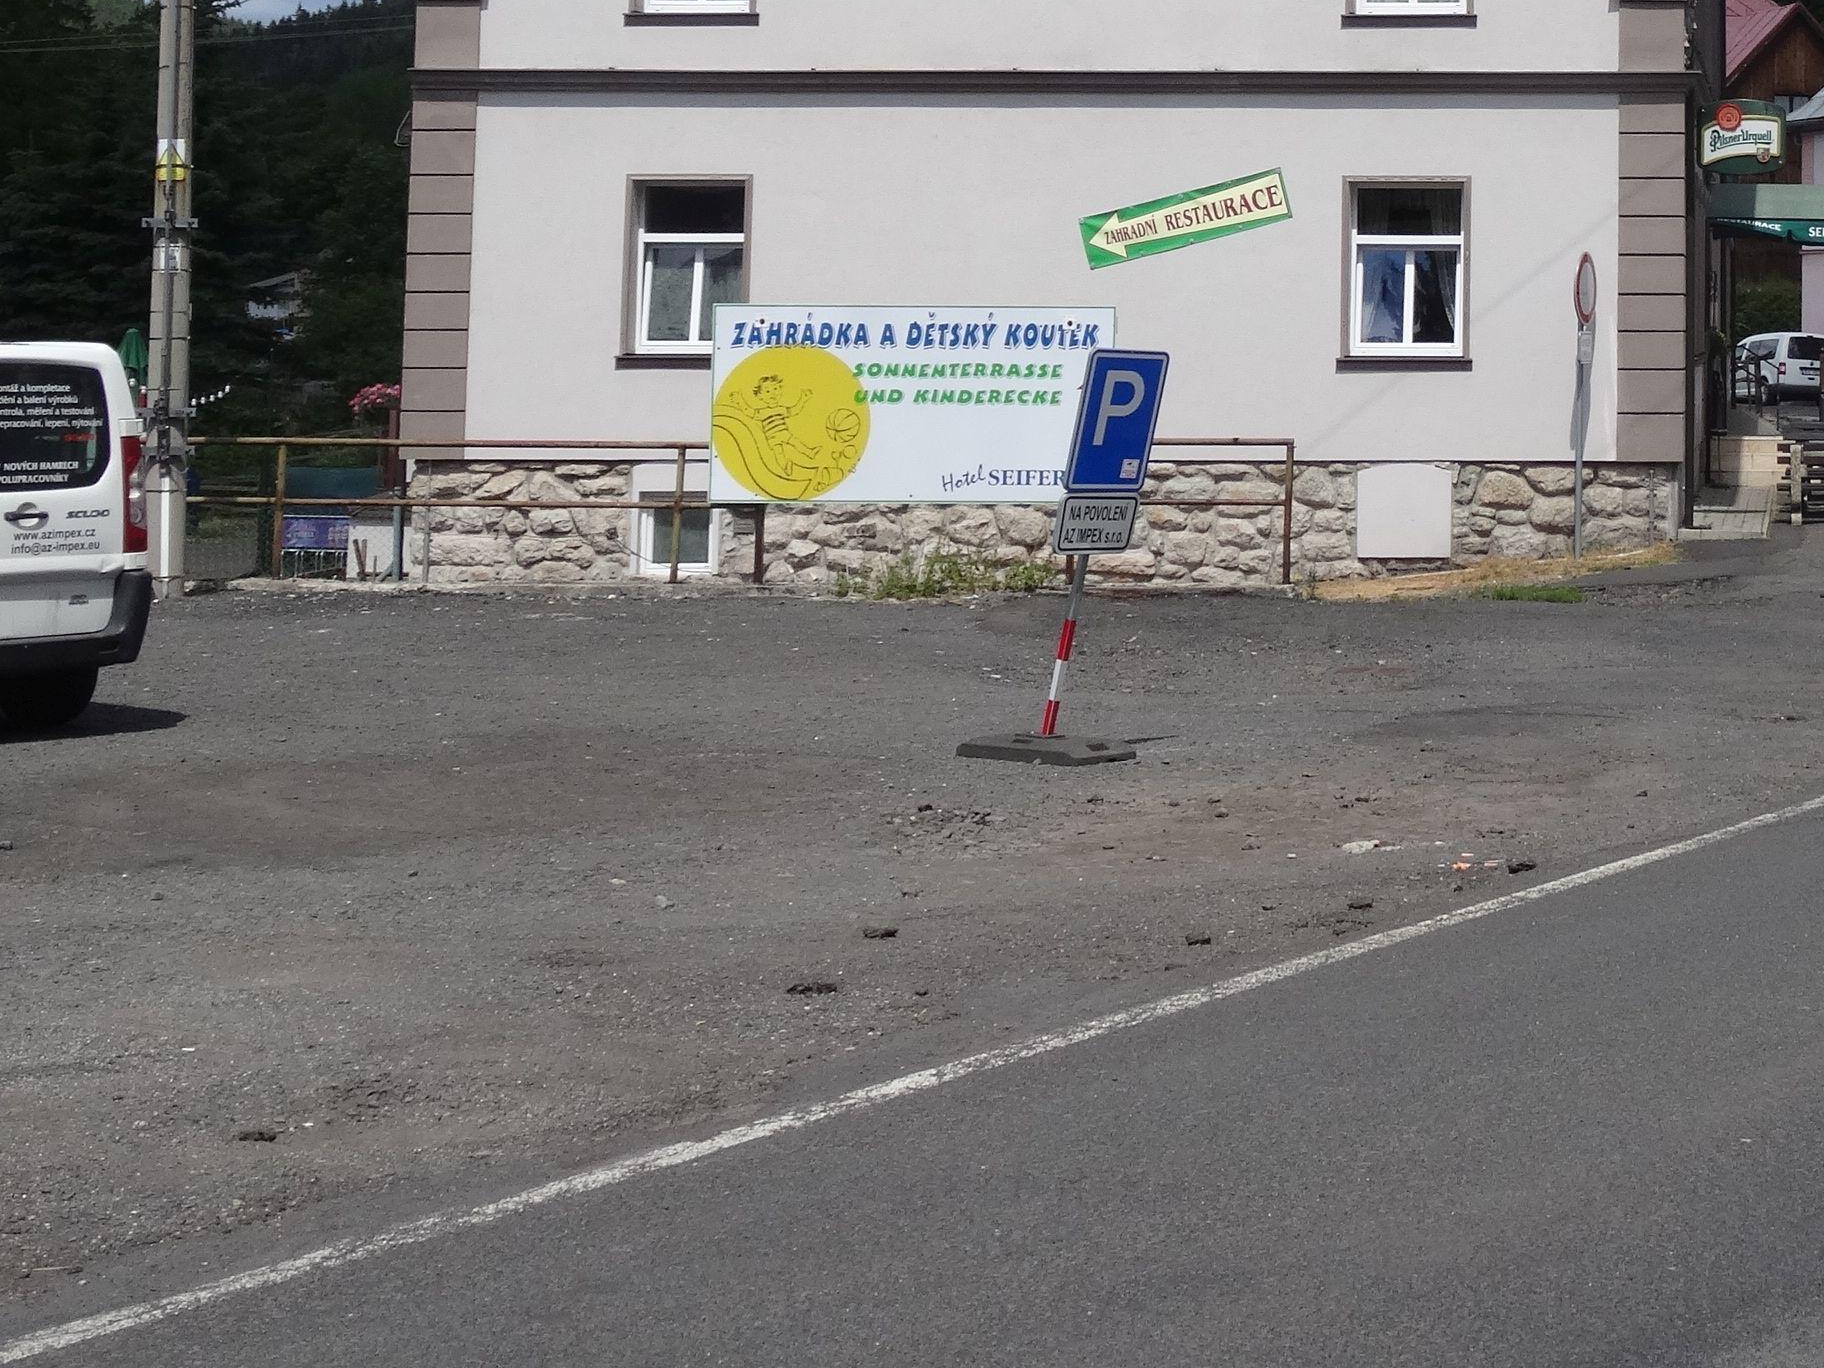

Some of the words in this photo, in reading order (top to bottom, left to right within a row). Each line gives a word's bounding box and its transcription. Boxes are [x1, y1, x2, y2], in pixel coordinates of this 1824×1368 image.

[1710, 129, 1742, 152] Pilsner
[1741, 130, 1772, 145] Urquell
[1104, 214, 1158, 245] ZAHRADNÍ
[1164, 184, 1283, 231] RESTAURACE
[731, 312, 869, 349] ZAHRÁDKA
[879, 322, 898, 349] A
[904, 312, 997, 349] DĚTSKÝ
[1003, 322, 1100, 349] KOUTEK
[853, 362, 1064, 379] SONNENTERRASSE
[27, 384, 71, 393] kompletace
[24, 396, 47, 404] balení
[48, 395, 79, 405] výrobků
[854, 388, 905, 405] UND
[913, 388, 1063, 406] KINDERECKE
[61, 407, 95, 415] testování
[1092, 369, 1145, 446] P
[71, 418, 103, 429] nýtování
[3, 460, 38, 471] NOVÝCH
[0, 473, 69, 484] OLUPRACOVNÍKY
[941, 463, 986, 492] Hotel
[987, 469, 1067, 486] SEIFER
[1069, 505, 1082, 521] NA
[1083, 502, 1129, 521] POVOLENÍ
[13, 528, 96, 541] www.azimpex.cz
[1063, 528, 1076, 543] AZ
[1076, 528, 1104, 543] IMPEX
[1104, 532, 1123, 543] s.r.o.
[11, 541, 100, 556] info@az-impex.eu
